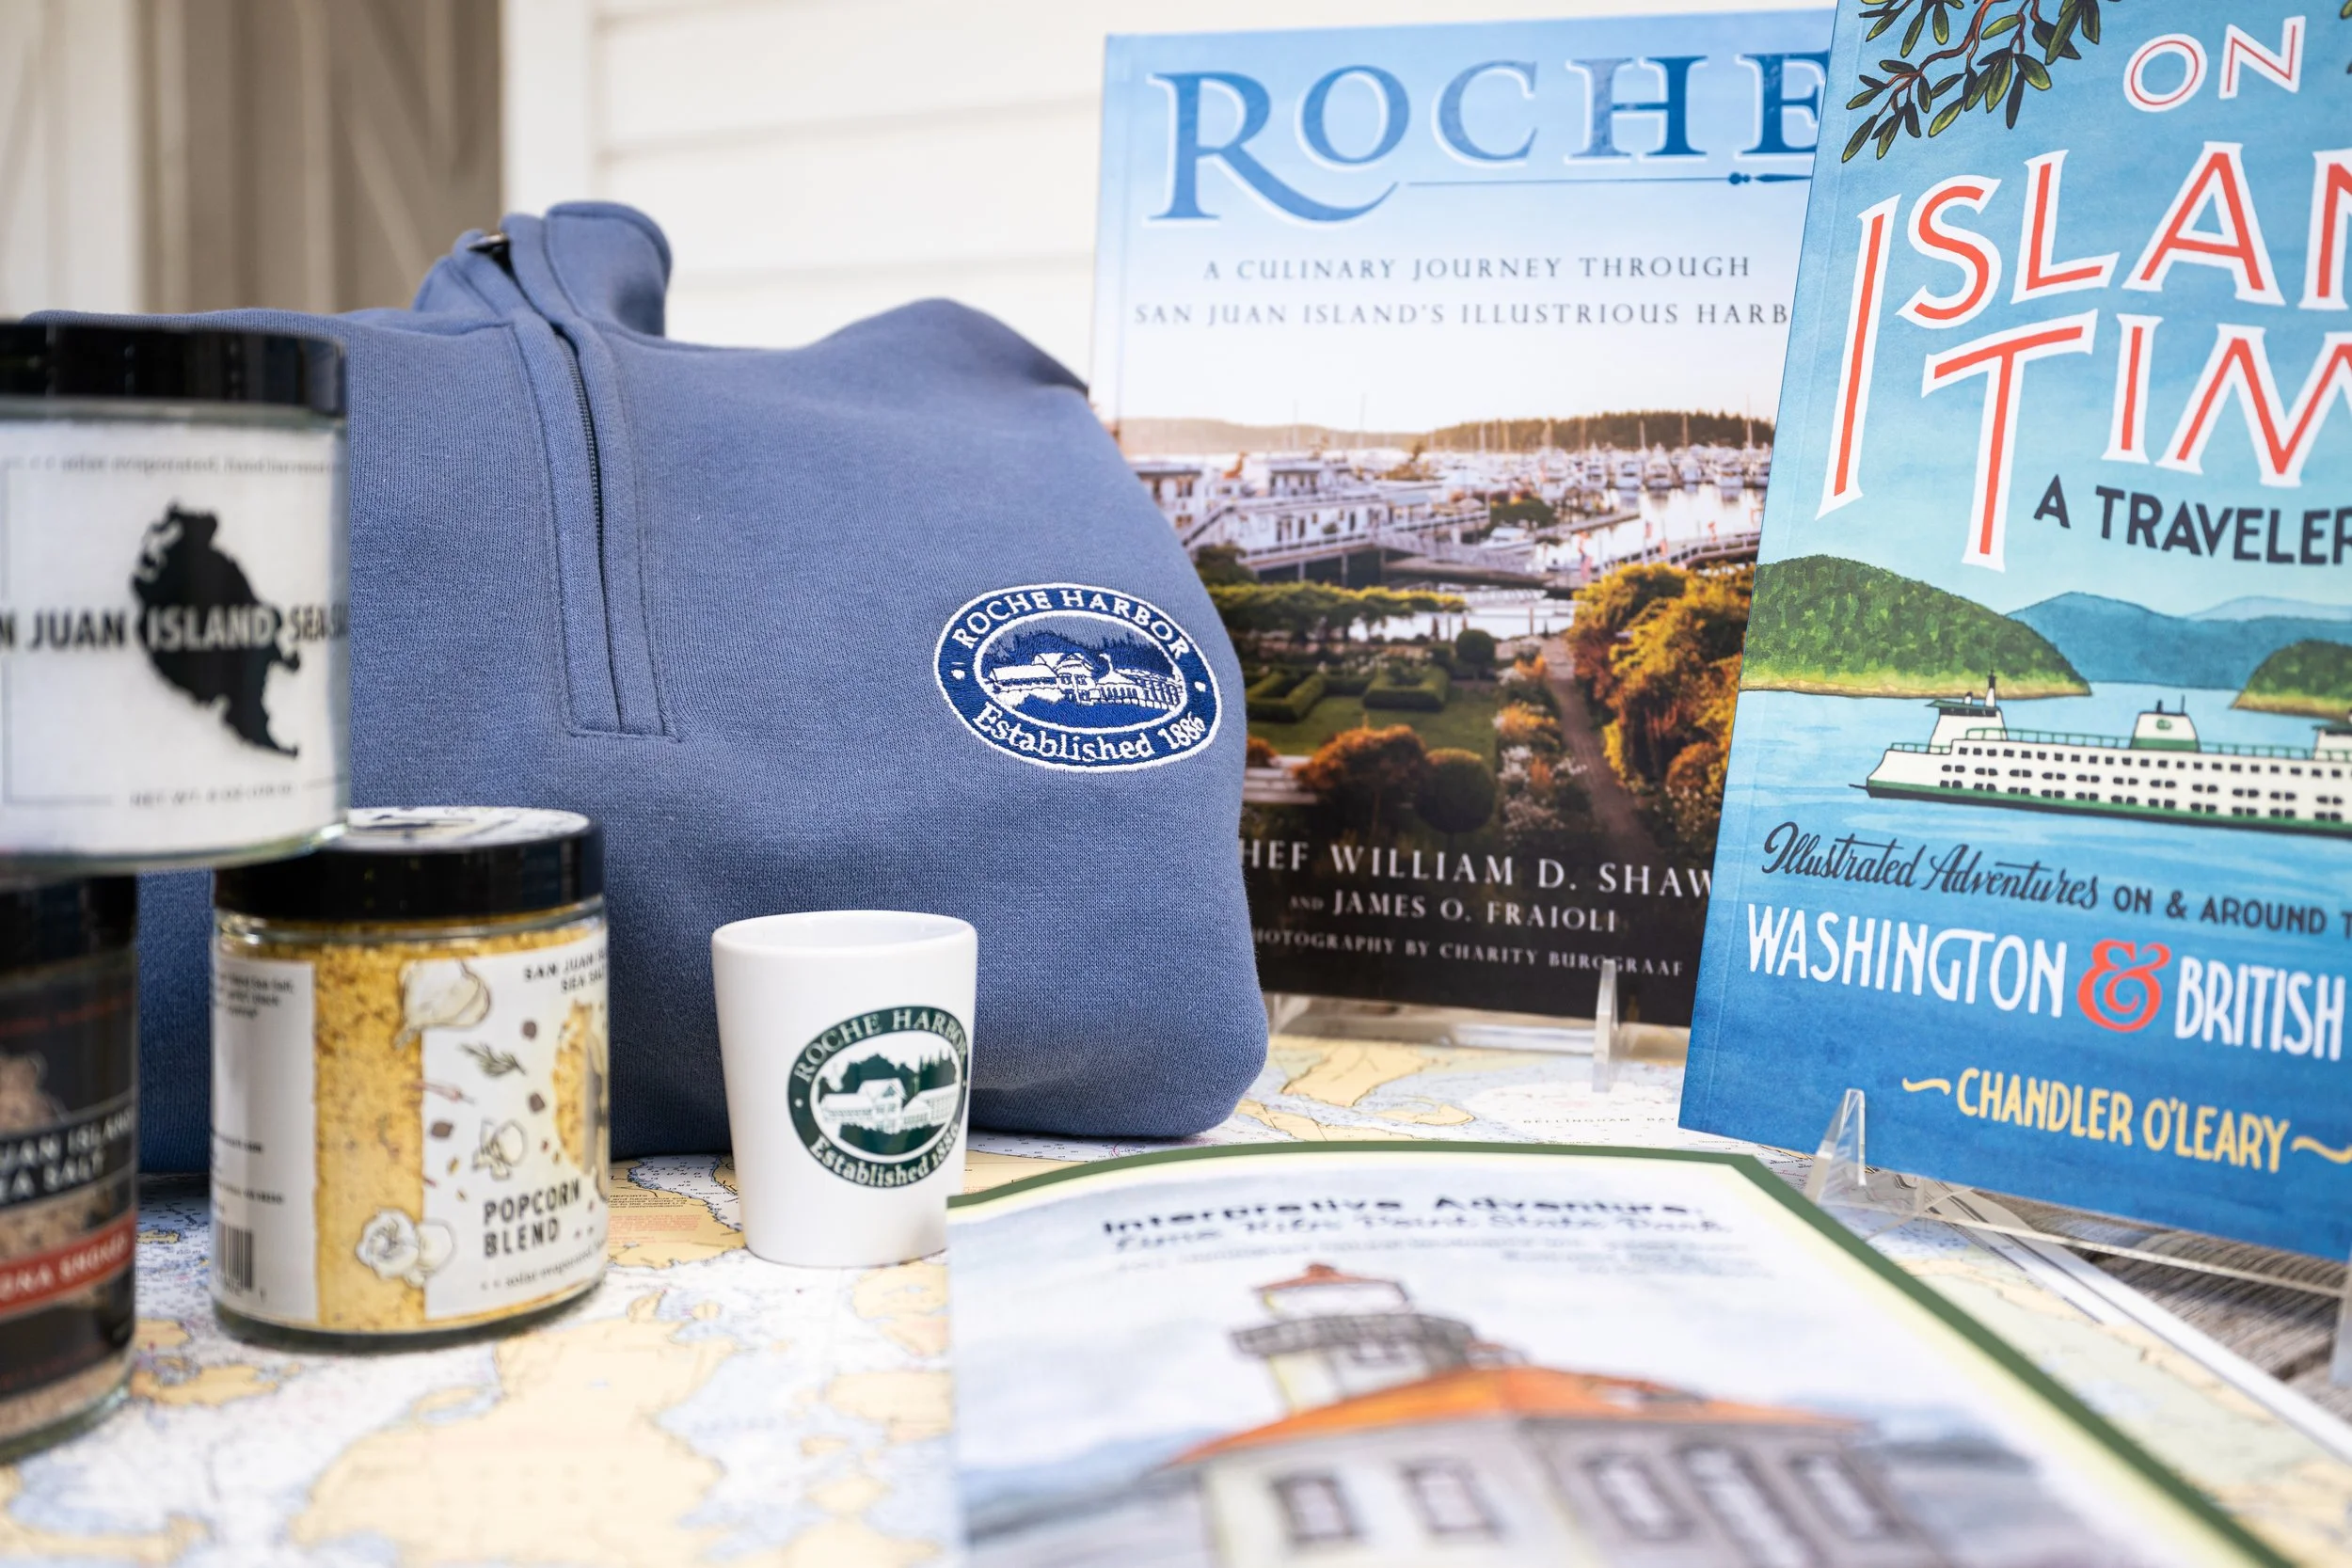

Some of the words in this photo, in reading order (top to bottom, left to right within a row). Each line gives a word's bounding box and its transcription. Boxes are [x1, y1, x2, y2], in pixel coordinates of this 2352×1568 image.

[2123, 15, 2306, 113] ON
[1142, 47, 1831, 228] ROCHE
[1202, 260, 1222, 280] A
[1235, 259, 1397, 280] CULINARY
[1412, 257, 1562, 282] JOURNEY
[1578, 255, 1752, 278] THROUGH
[1134, 303, 1192, 325] SAN
[1207, 302, 1288, 327] JUAN
[1303, 302, 1445, 325] ISLAND'S
[1460, 302, 1679, 325] ILLUSTRIOUS
[1697, 302, 1788, 325] HARB
[1815, 141, 2352, 521] ISLAN
[1921, 309, 2352, 574] TIM
[2033, 474, 2072, 530] A
[2094, 484, 2352, 566] TRAVELER
[27, 610, 128, 651] JUAN
[146, 605, 275, 650] ISLAND
[952, 591, 1053, 650] ROCHE
[1059, 589, 1191, 660] HARBOR
[972, 703, 1153, 764] Established
[1157, 711, 1207, 752] 1886
[1239, 838, 1309, 872] HEF
[1329, 843, 1514, 887] WILLIAM
[1538, 858, 1578, 891] D.
[1598, 862, 1712, 898] SHAW
[1761, 821, 1927, 889] Illustrated
[1920, 843, 2099, 911] Adventures
[2113, 886, 2153, 915] ON
[2165, 891, 2187, 919] &
[2199, 895, 2328, 936] AROUND
[1289, 895, 1325, 911] AND
[1333, 889, 1426, 918] JAMES
[1440, 896, 1472, 922] O.
[1486, 900, 1616, 933] FRAIOLI
[523, 961, 557, 983] SAN
[562, 951, 594, 975] JUAN
[1253, 927, 1396, 954] HOTOGRAPHY
[1404, 938, 1431, 957] BY
[1439, 942, 1538, 967] CHARITY
[1748, 903, 2068, 1019] WASHINGTON
[2076, 939, 2173, 1035] &
[2174, 955, 2346, 1063] BRITISH
[793, 1011, 882, 1085] ROCHE
[892, 1007, 968, 1065] HARBOR
[1956, 1067, 2134, 1147] CHANDLER
[2141, 1097, 2291, 1174] O'LEARY
[0, 1132, 62, 1173] UAN
[43, 1147, 105, 1193] SALT
[810, 1134, 930, 1188] Established
[931, 1122, 960, 1170] 1886
[484, 1178, 581, 1227] POPCORN
[484, 1216, 560, 1259] BLEND
